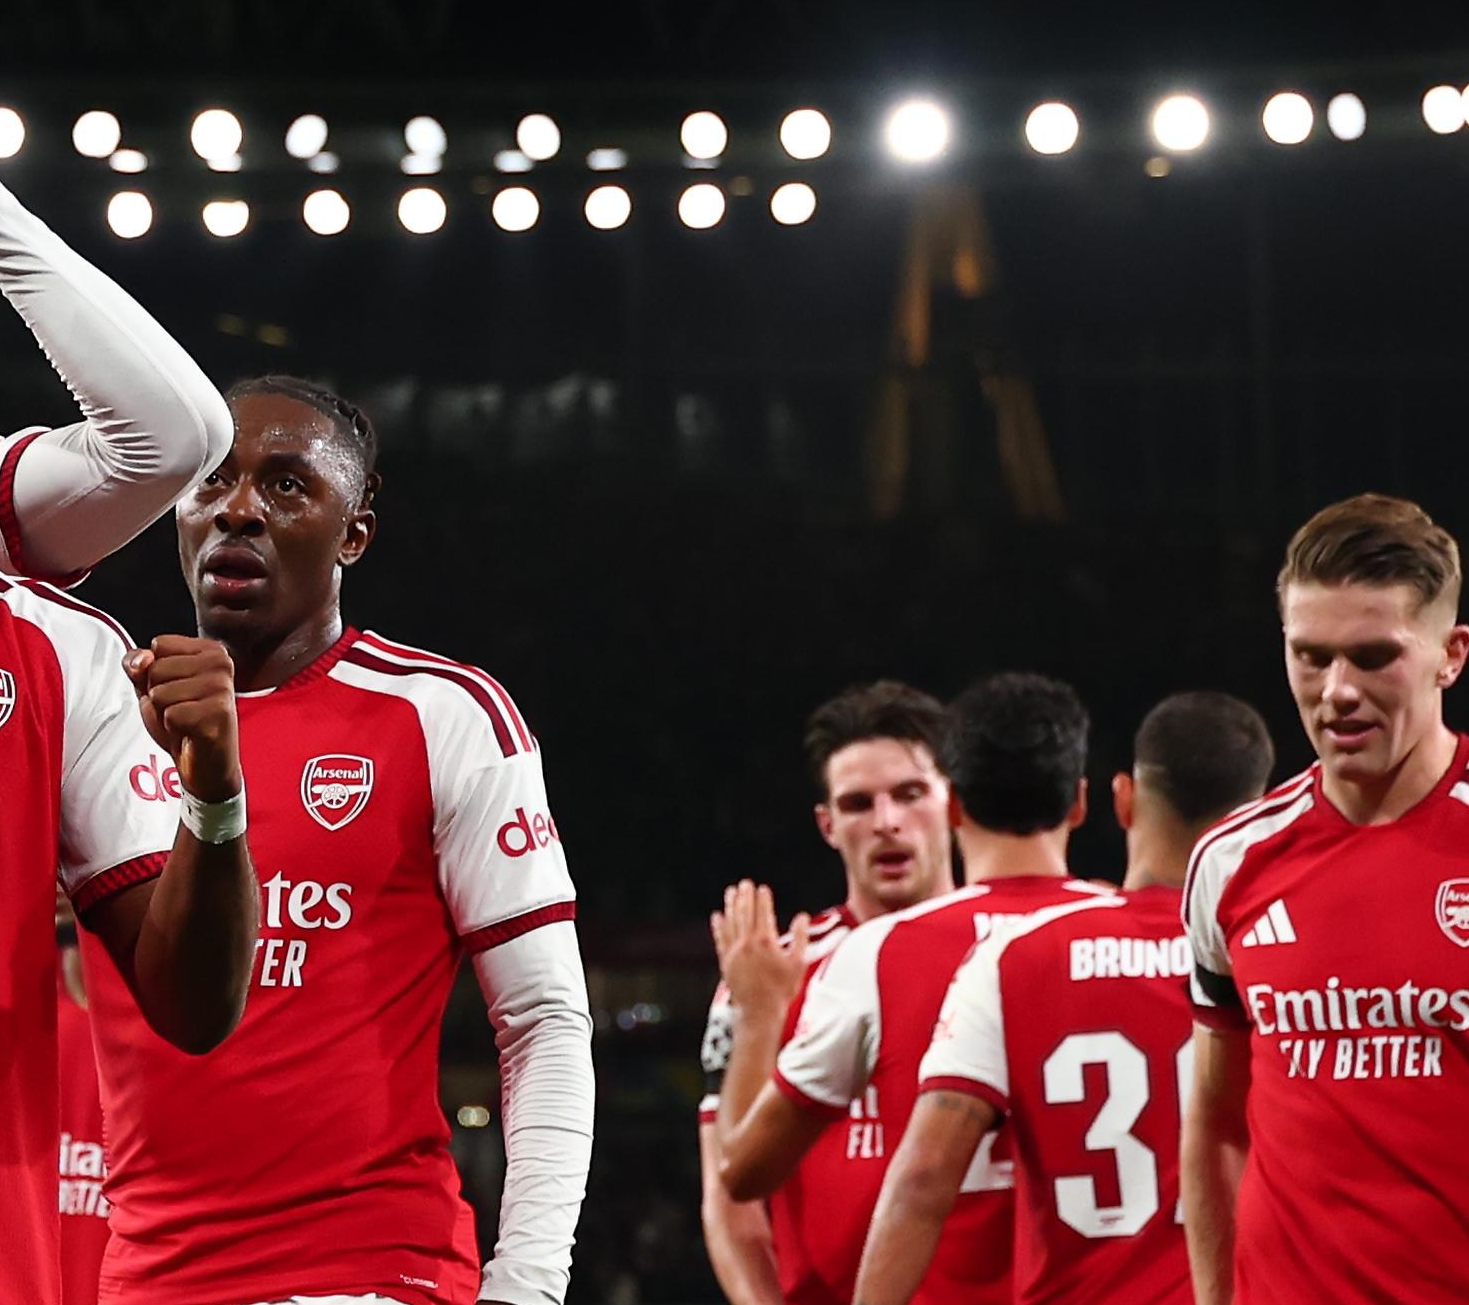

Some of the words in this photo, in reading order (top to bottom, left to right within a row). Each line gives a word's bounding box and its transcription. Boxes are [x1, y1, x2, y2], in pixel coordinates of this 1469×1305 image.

[313, 766, 364, 780] Arsenal
[1070, 937, 1193, 981] BRUNO
[1333, 1035, 1443, 1080] BETTER
[1043, 1031, 1195, 1237] 3
